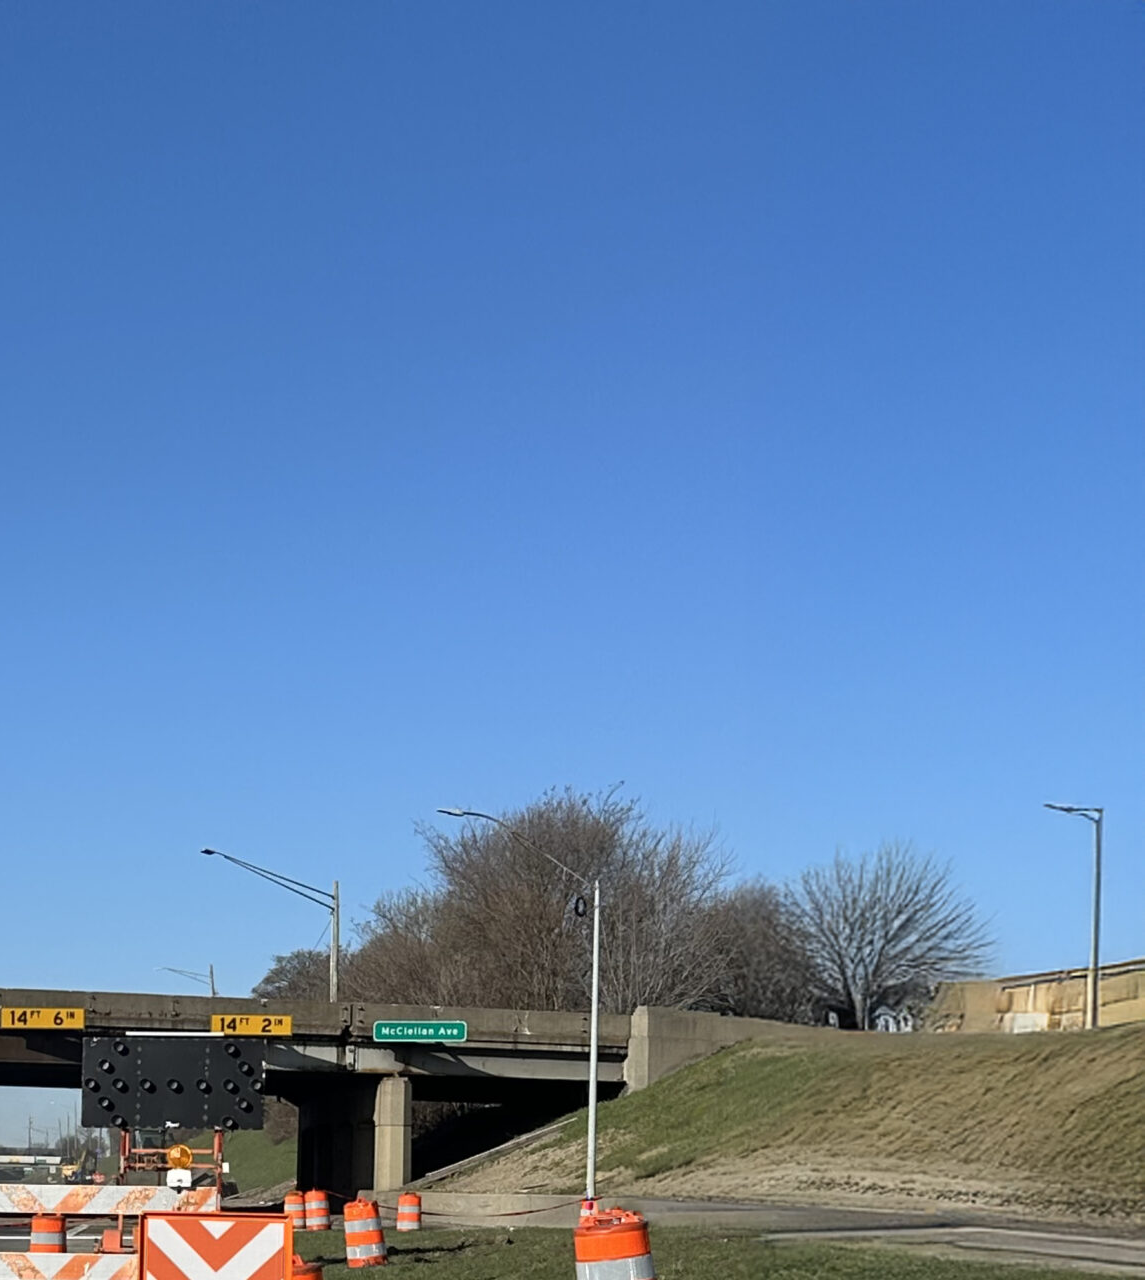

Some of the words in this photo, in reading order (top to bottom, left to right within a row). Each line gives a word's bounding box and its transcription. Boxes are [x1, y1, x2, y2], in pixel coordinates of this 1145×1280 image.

[10, 1010, 28, 1026] 14
[30, 1010, 41, 1019] FT
[53, 1011, 64, 1026] 6
[66, 1011, 75, 1020] IN
[220, 1017, 237, 1032] 14
[239, 1017, 250, 1026] FT
[261, 1017, 272, 1033] 2
[274, 1018, 283, 1026] IN
[381, 1026, 434, 1036] McClellan
[438, 1026, 459, 1036] Ave
